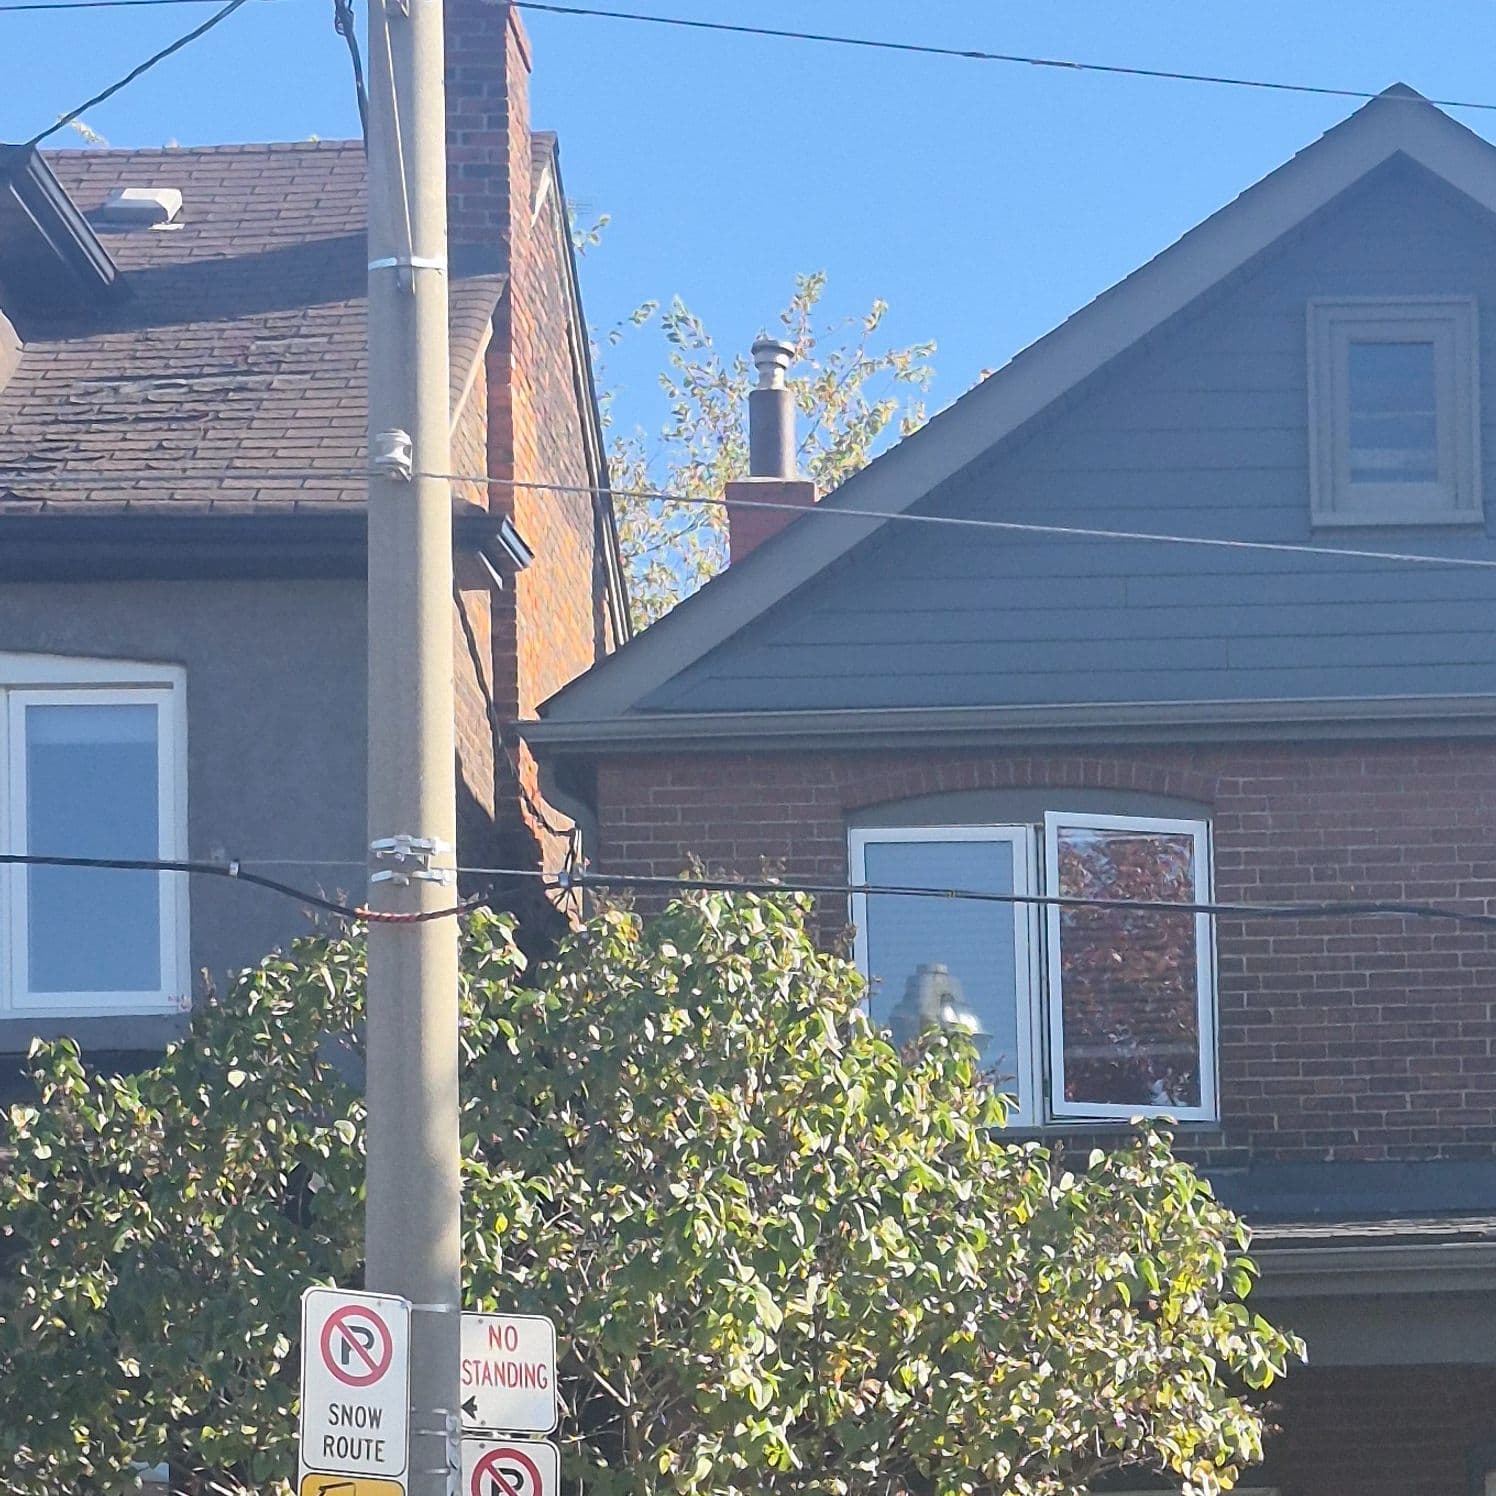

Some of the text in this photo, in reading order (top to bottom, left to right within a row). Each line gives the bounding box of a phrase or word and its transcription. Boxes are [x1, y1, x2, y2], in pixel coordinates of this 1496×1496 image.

[487, 1324, 518, 1352] NO
[462, 1358, 548, 1390] STANDING
[327, 1402, 383, 1430] SNOW
[323, 1434, 385, 1463] ROUTE
